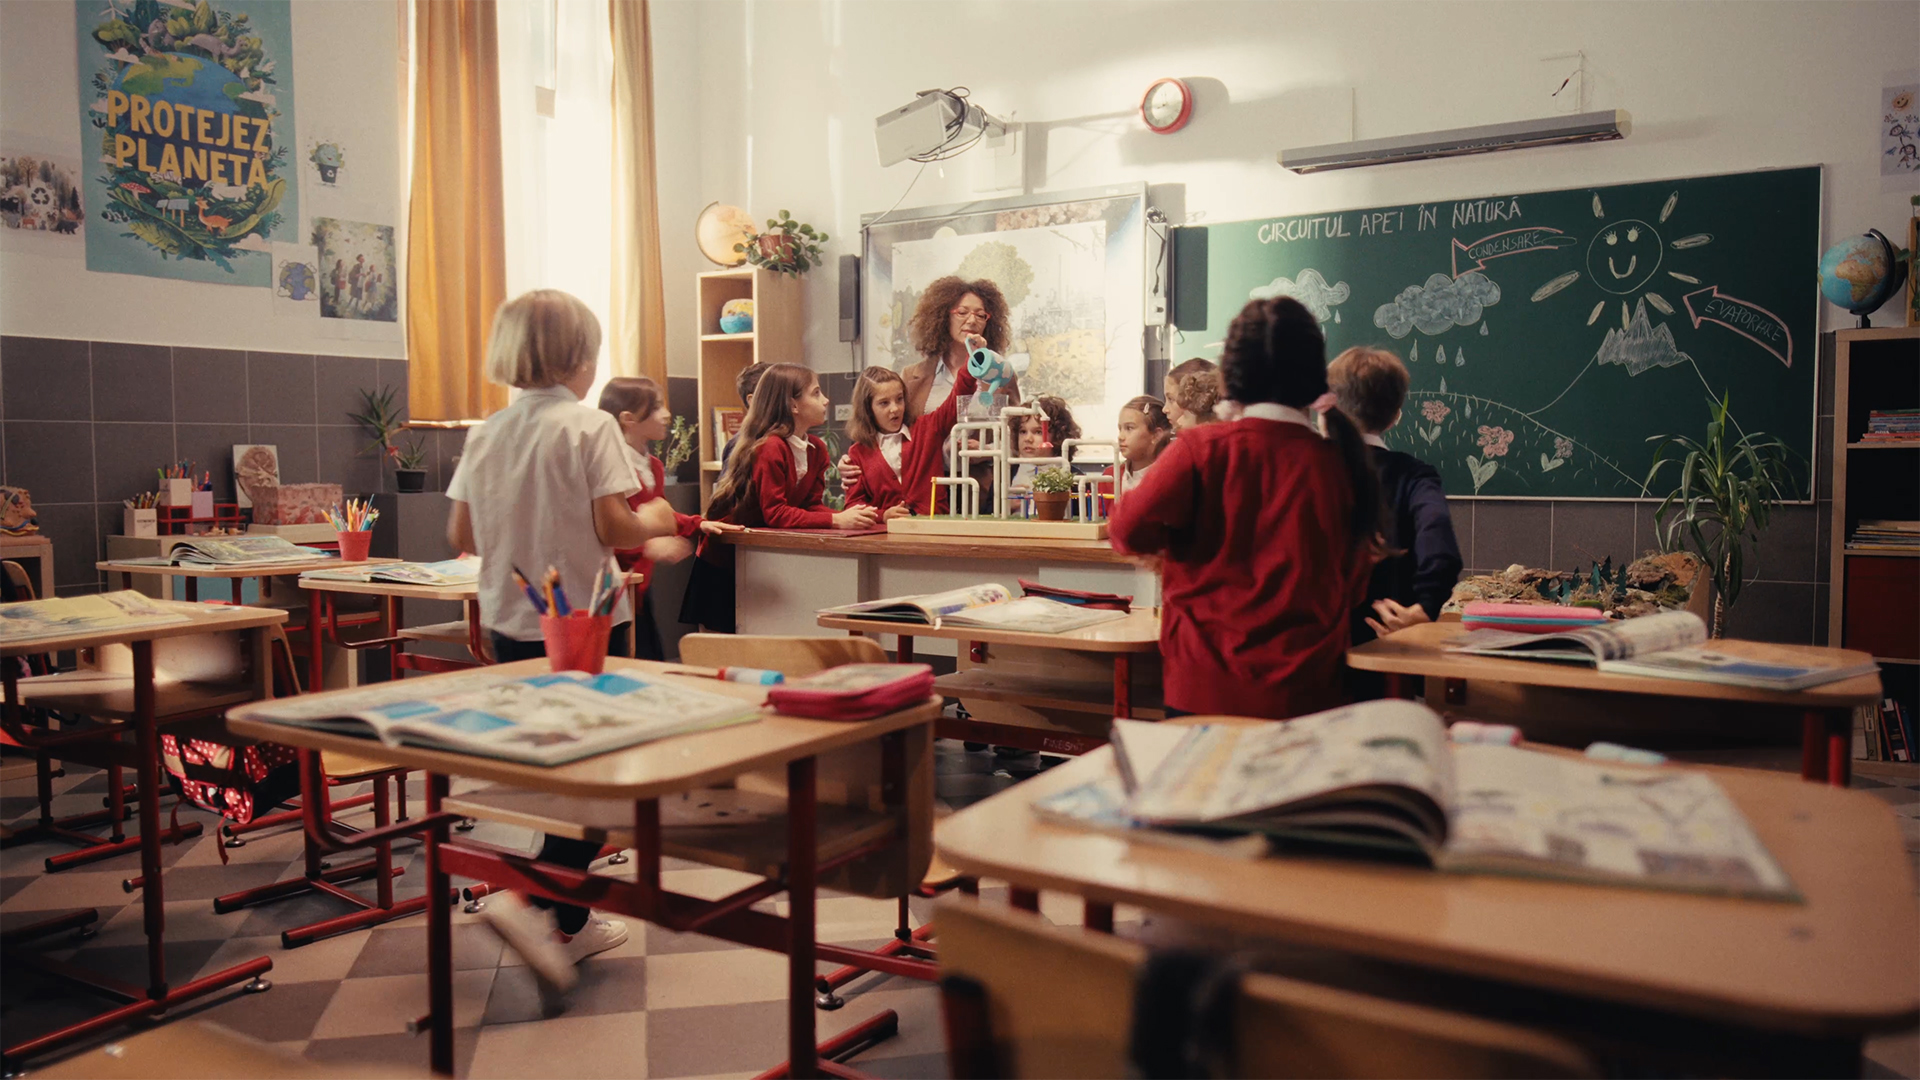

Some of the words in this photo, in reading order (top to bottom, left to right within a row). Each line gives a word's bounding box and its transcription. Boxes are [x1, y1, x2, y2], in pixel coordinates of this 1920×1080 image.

[107, 90, 270, 153] PROTEJEZ
[1257, 214, 1351, 244] CIRCUITUL
[1359, 208, 1404, 237] APEI
[1418, 204, 1437, 231] ÎN
[1452, 196, 1522, 229] NATURĂ
[1468, 230, 1542, 260] CONDENSARE
